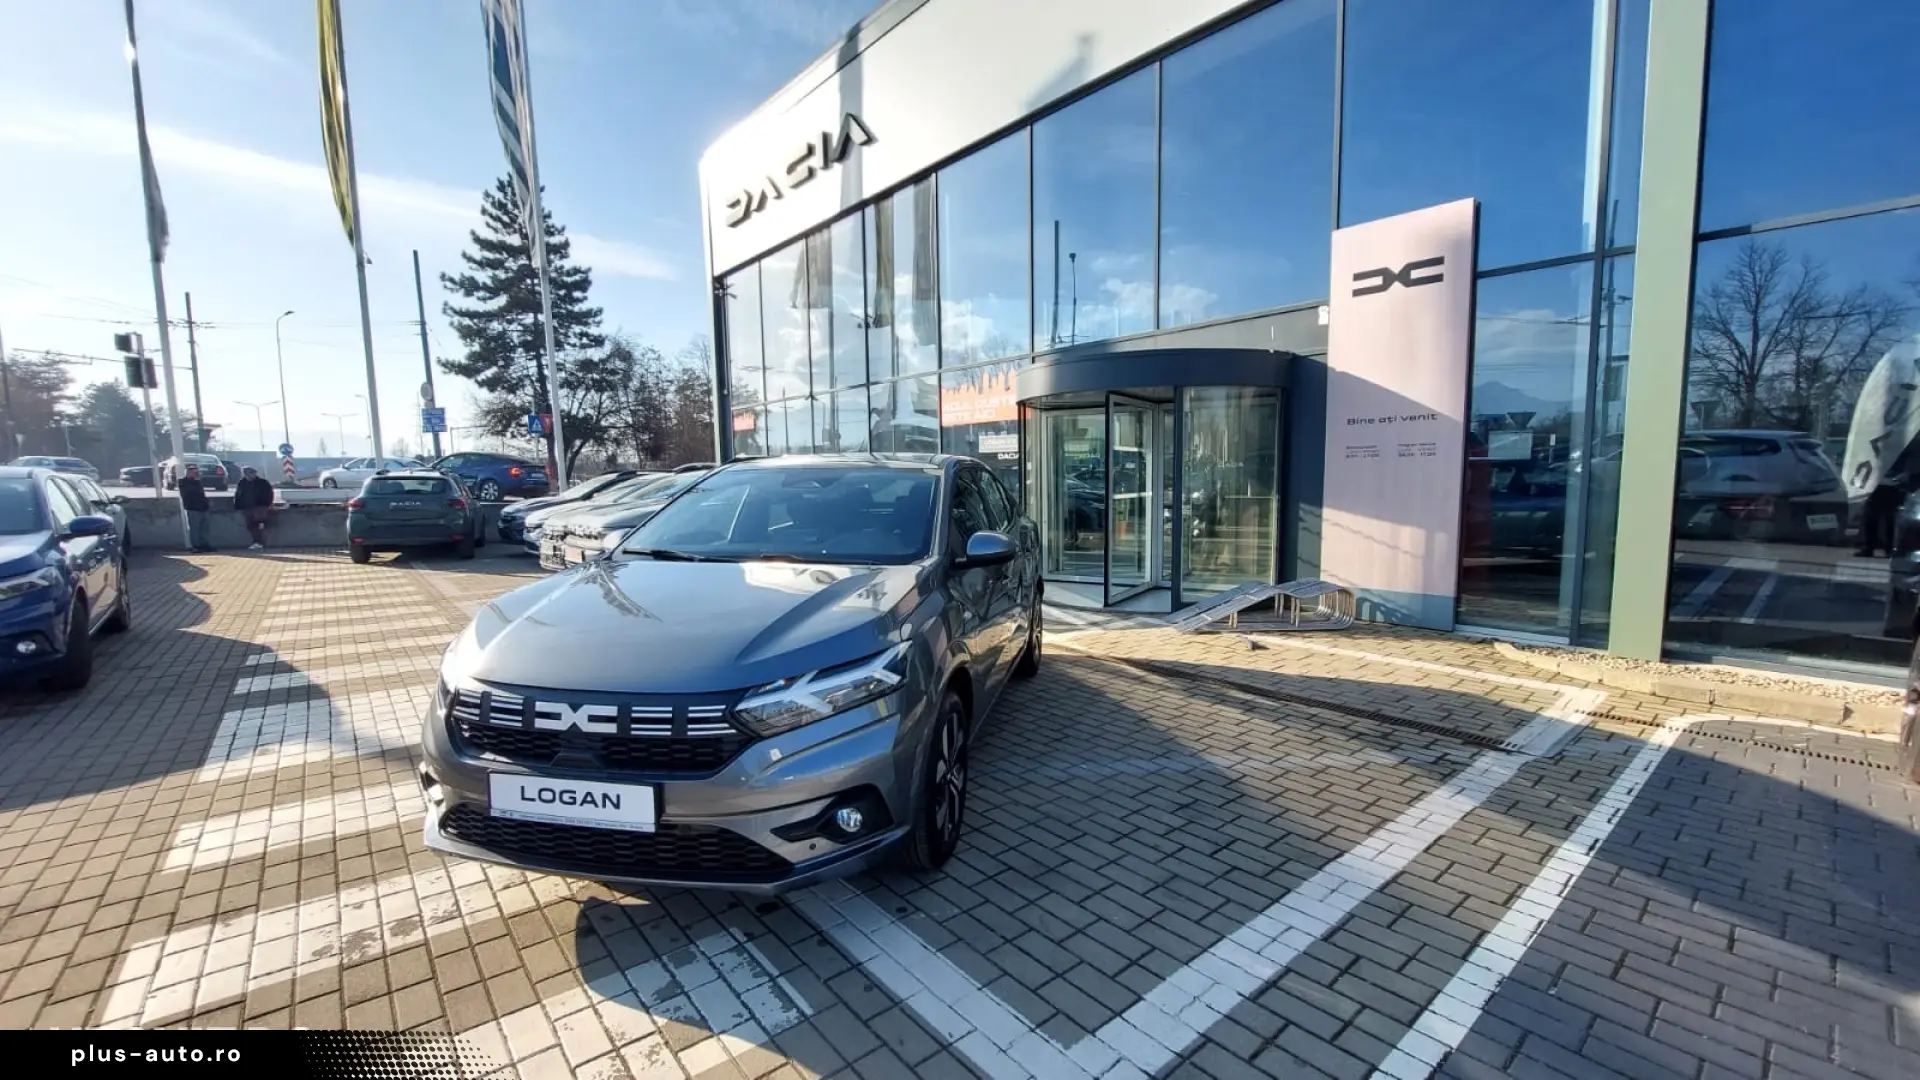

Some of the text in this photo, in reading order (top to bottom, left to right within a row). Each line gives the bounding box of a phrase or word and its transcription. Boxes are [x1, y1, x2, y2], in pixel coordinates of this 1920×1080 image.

[727, 112, 878, 227] DACIA
[1346, 417, 1375, 426] Bine
[1401, 413, 1438, 422] venit
[520, 785, 621, 810] LOGAN
